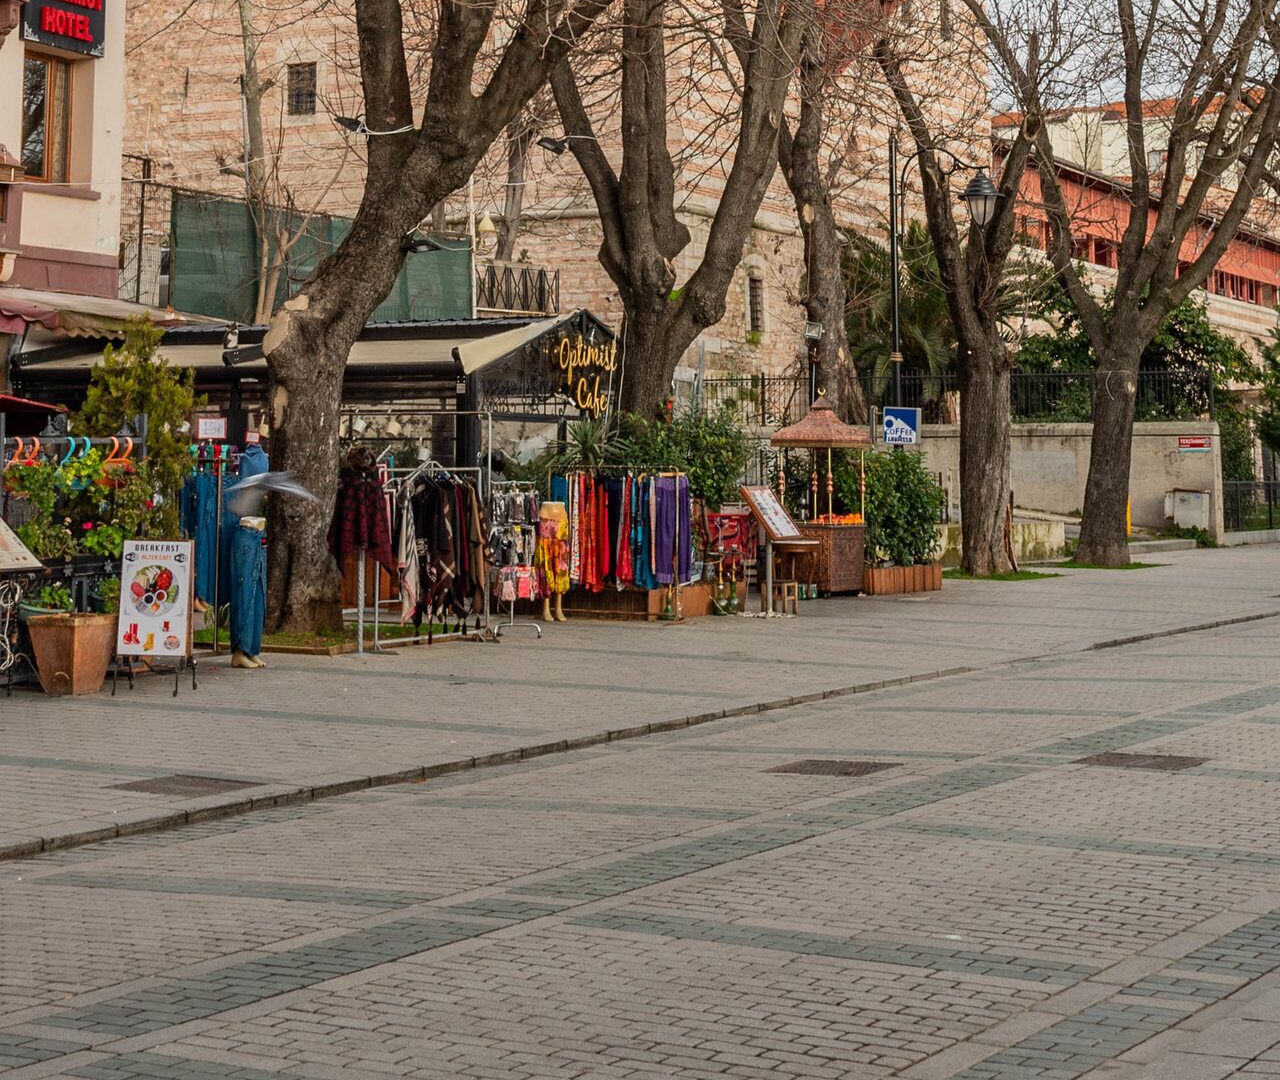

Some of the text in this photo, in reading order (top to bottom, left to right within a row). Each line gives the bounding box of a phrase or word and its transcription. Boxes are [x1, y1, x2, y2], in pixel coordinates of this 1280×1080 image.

[41, 6, 93, 42] HOTEL
[560, 335, 617, 385] Optimist
[578, 376, 608, 419] Cafe
[886, 427, 913, 436] COFFEE
[135, 544, 180, 552] BREAKFAST
